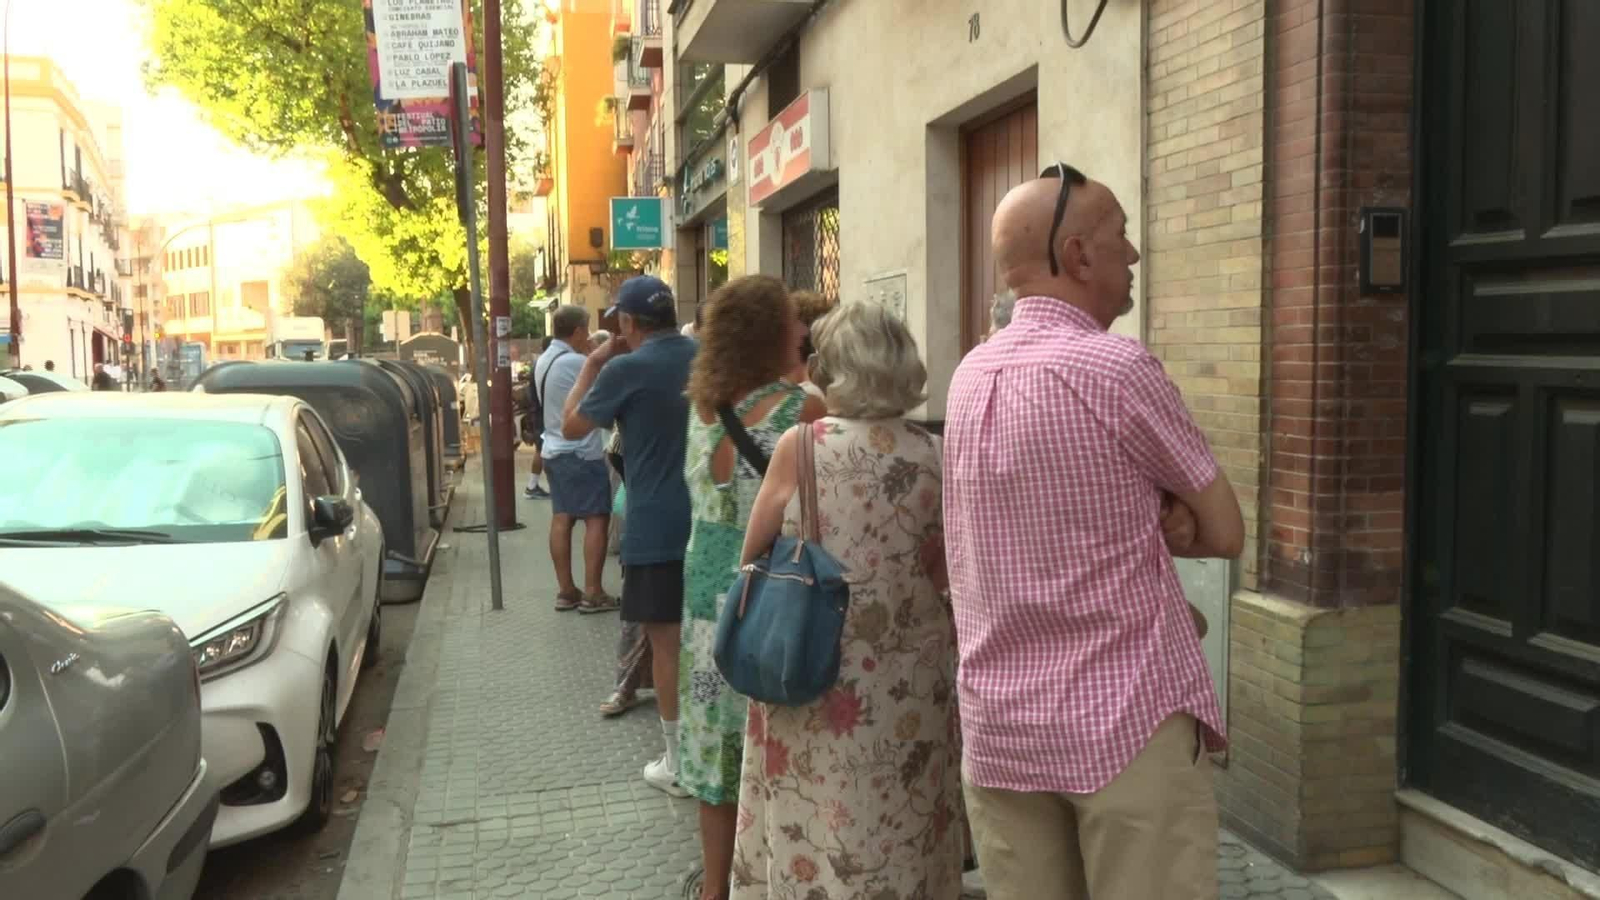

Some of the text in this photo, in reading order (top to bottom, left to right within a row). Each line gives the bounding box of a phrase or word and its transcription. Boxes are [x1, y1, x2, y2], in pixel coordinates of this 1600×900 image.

[388, 12, 431, 21] GINEBRAS
[390, 27, 459, 37] ABRAHAM MATEO
[418, 40, 455, 50] QUIJANO
[393, 53, 420, 61] PABLO
[394, 68, 410, 76] LUZ
[395, 79, 447, 88] LA PLAZUEL
